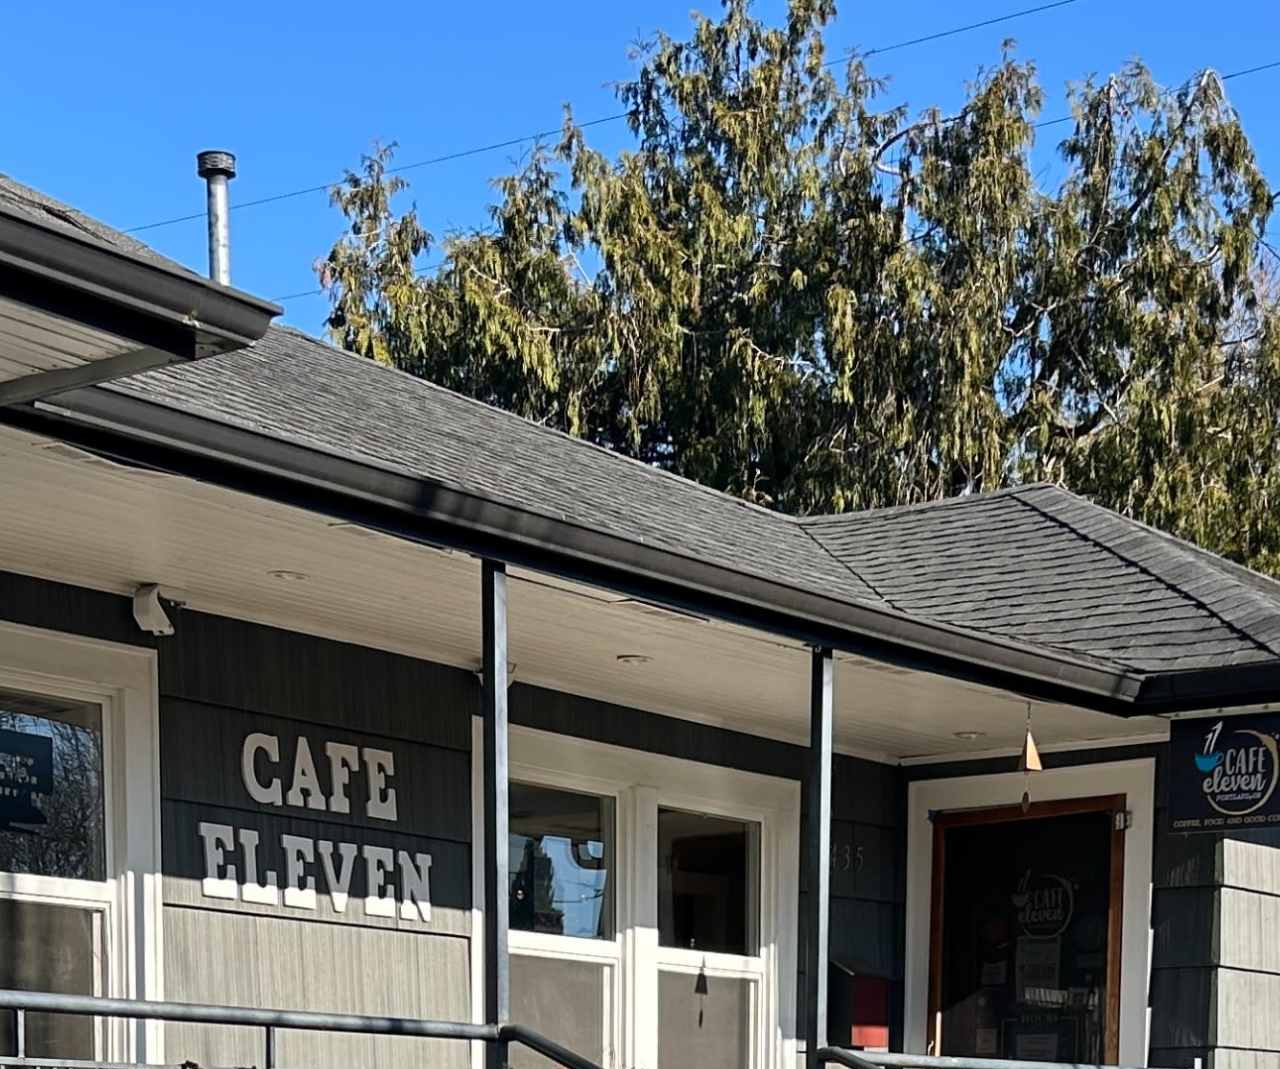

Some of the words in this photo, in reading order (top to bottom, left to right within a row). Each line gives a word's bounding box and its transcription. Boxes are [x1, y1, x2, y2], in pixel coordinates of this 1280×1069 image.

[241, 732, 397, 821] CAFE
[1202, 765, 1268, 793] eleven
[1225, 746, 1268, 775] CAFE
[200, 822, 432, 922] ELEVEN
